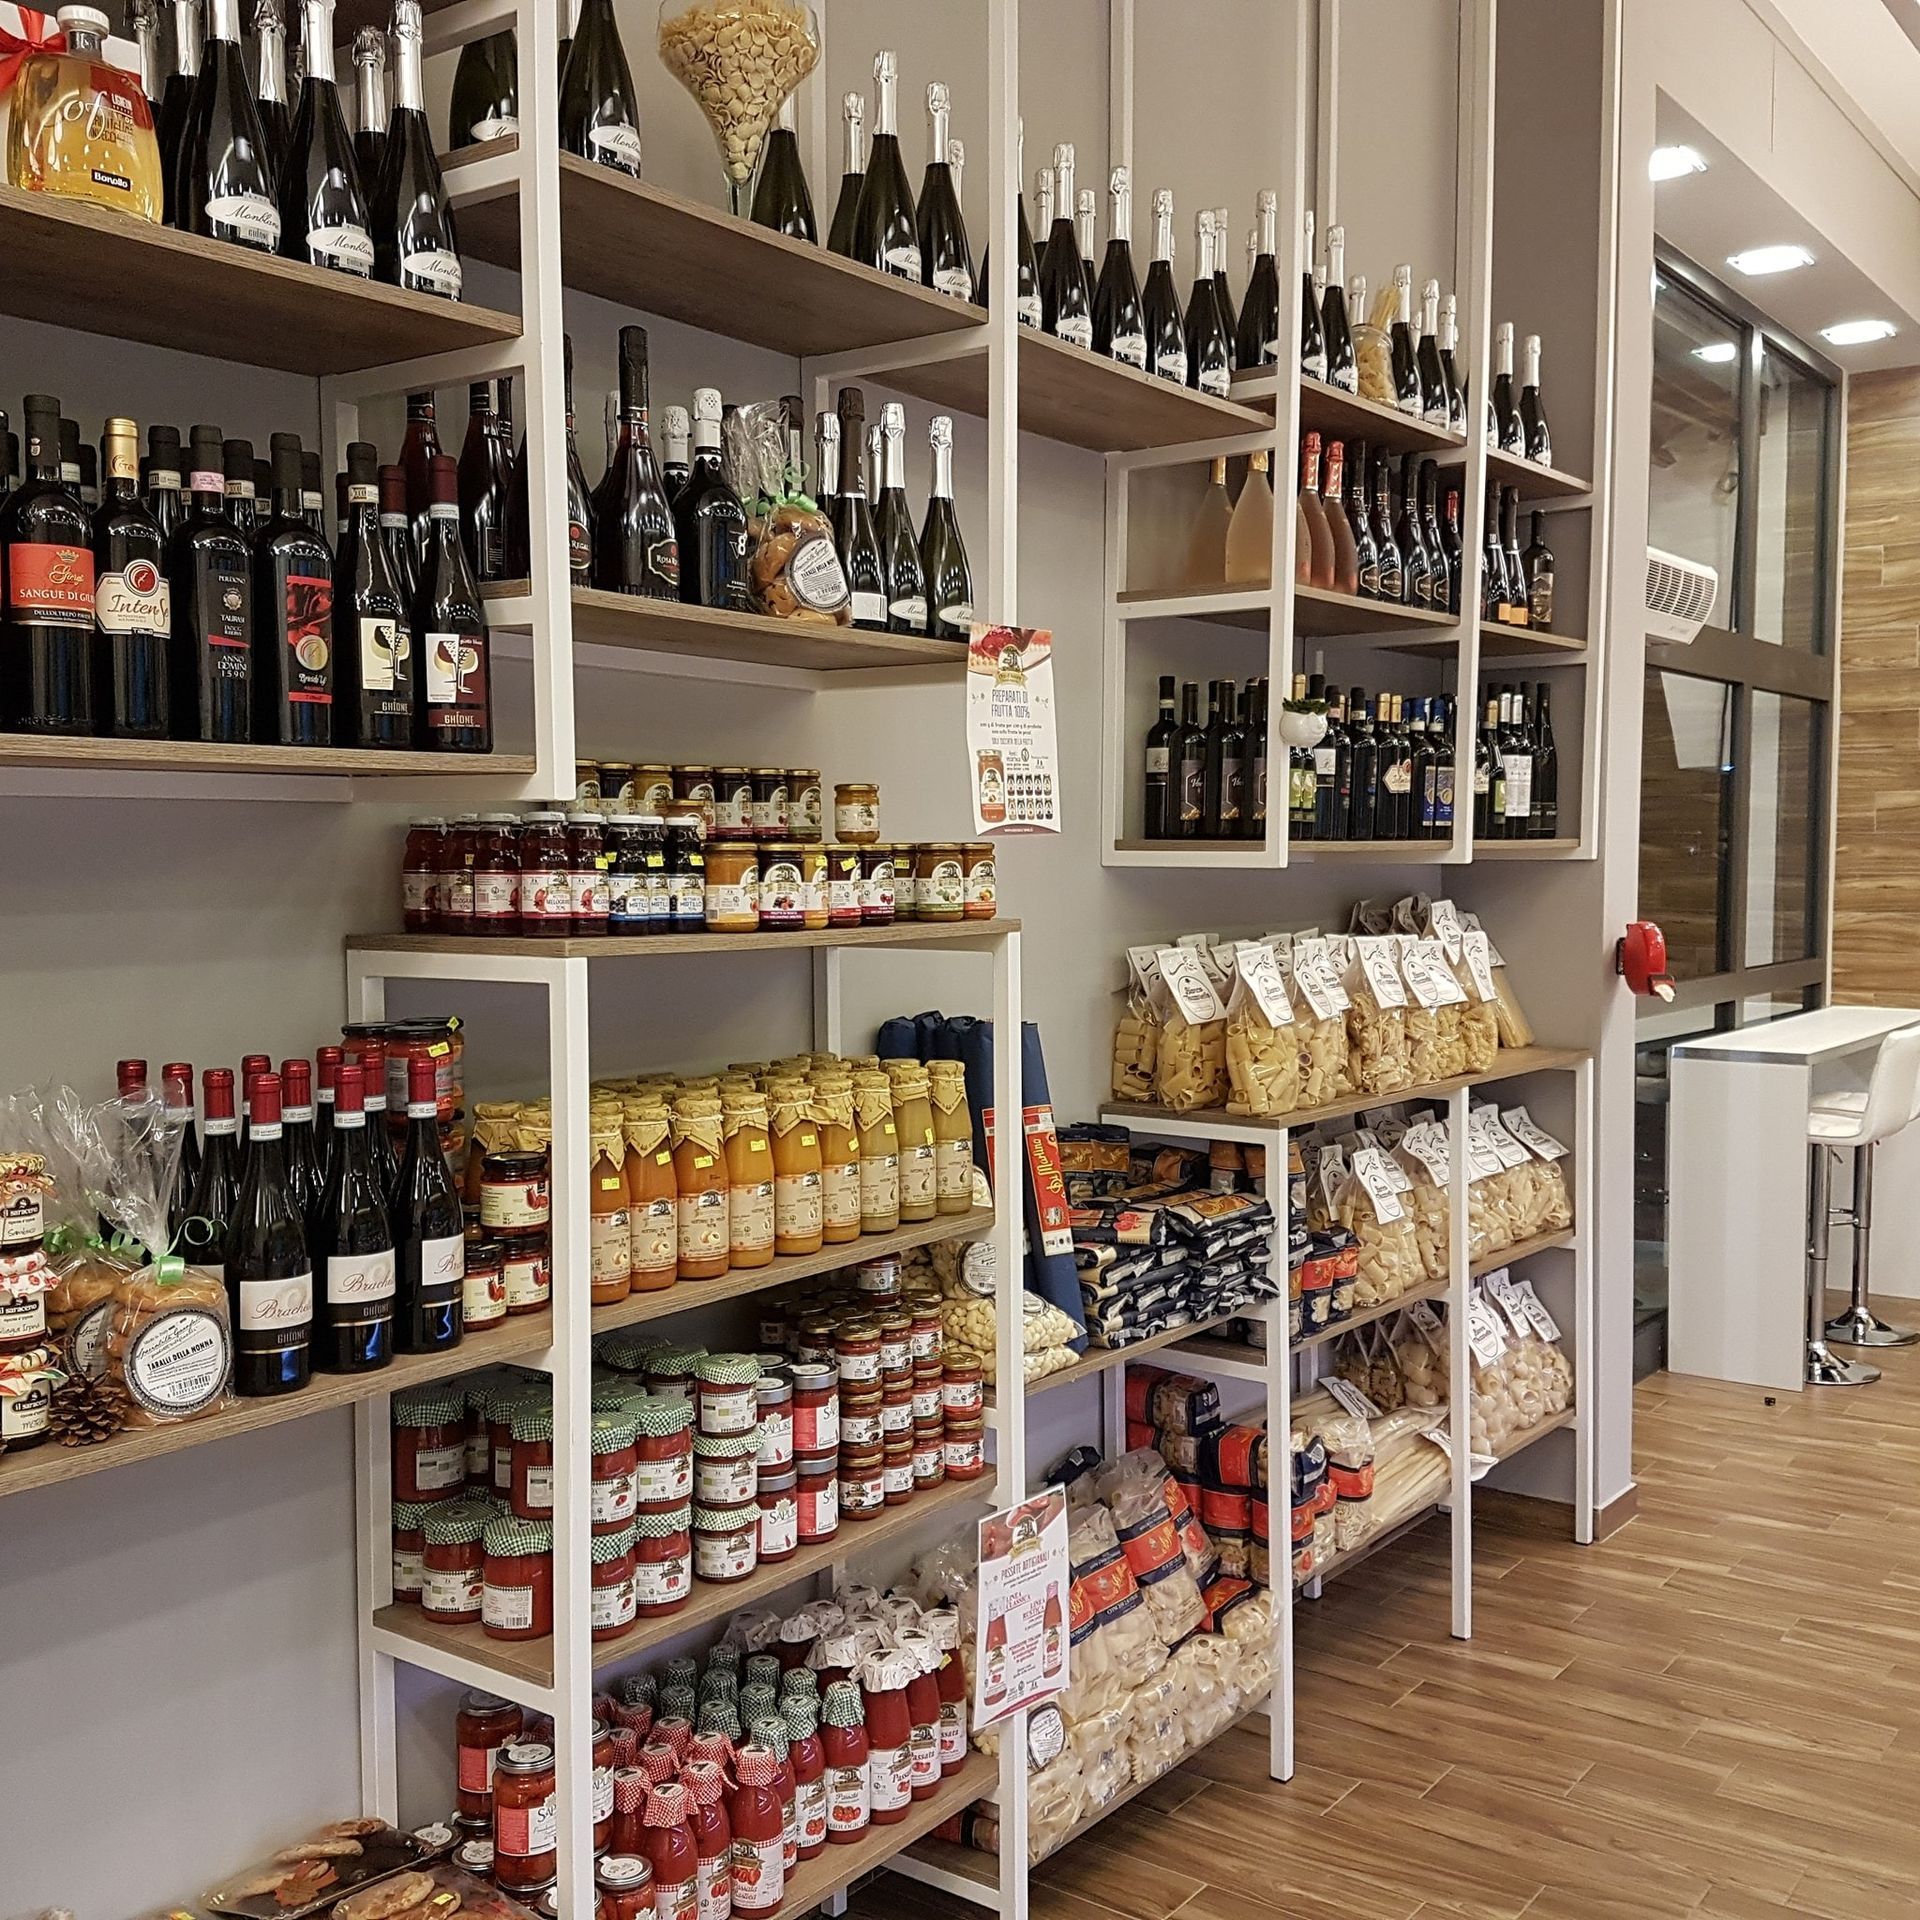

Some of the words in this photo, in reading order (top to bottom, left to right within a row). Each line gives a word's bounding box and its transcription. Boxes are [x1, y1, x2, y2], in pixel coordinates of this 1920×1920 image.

[94, 171, 129, 189] Bonollo
[20, 588, 64, 600] SANGUE
[67, 591, 78, 601] DI
[221, 655, 245, 663] ANNO
[217, 661, 247, 671] DOMINI
[221, 670, 245, 679] 1590
[992, 689, 1021, 703] PREPARATI
[1022, 691, 1029, 704] DI
[382, 699, 408, 712] GHIONE
[991, 704, 1013, 717] FRUTTA
[1014, 706, 1031, 719] 100%
[444, 711, 474, 725] GHIONE
[6, 1303, 37, 1313] saraceno
[147, 1353, 173, 1370] TARALLI
[173, 1347, 190, 1361] DELLA
[190, 1338, 214, 1353] NONNA
[1001, 1562, 1021, 1581] PASSATE
